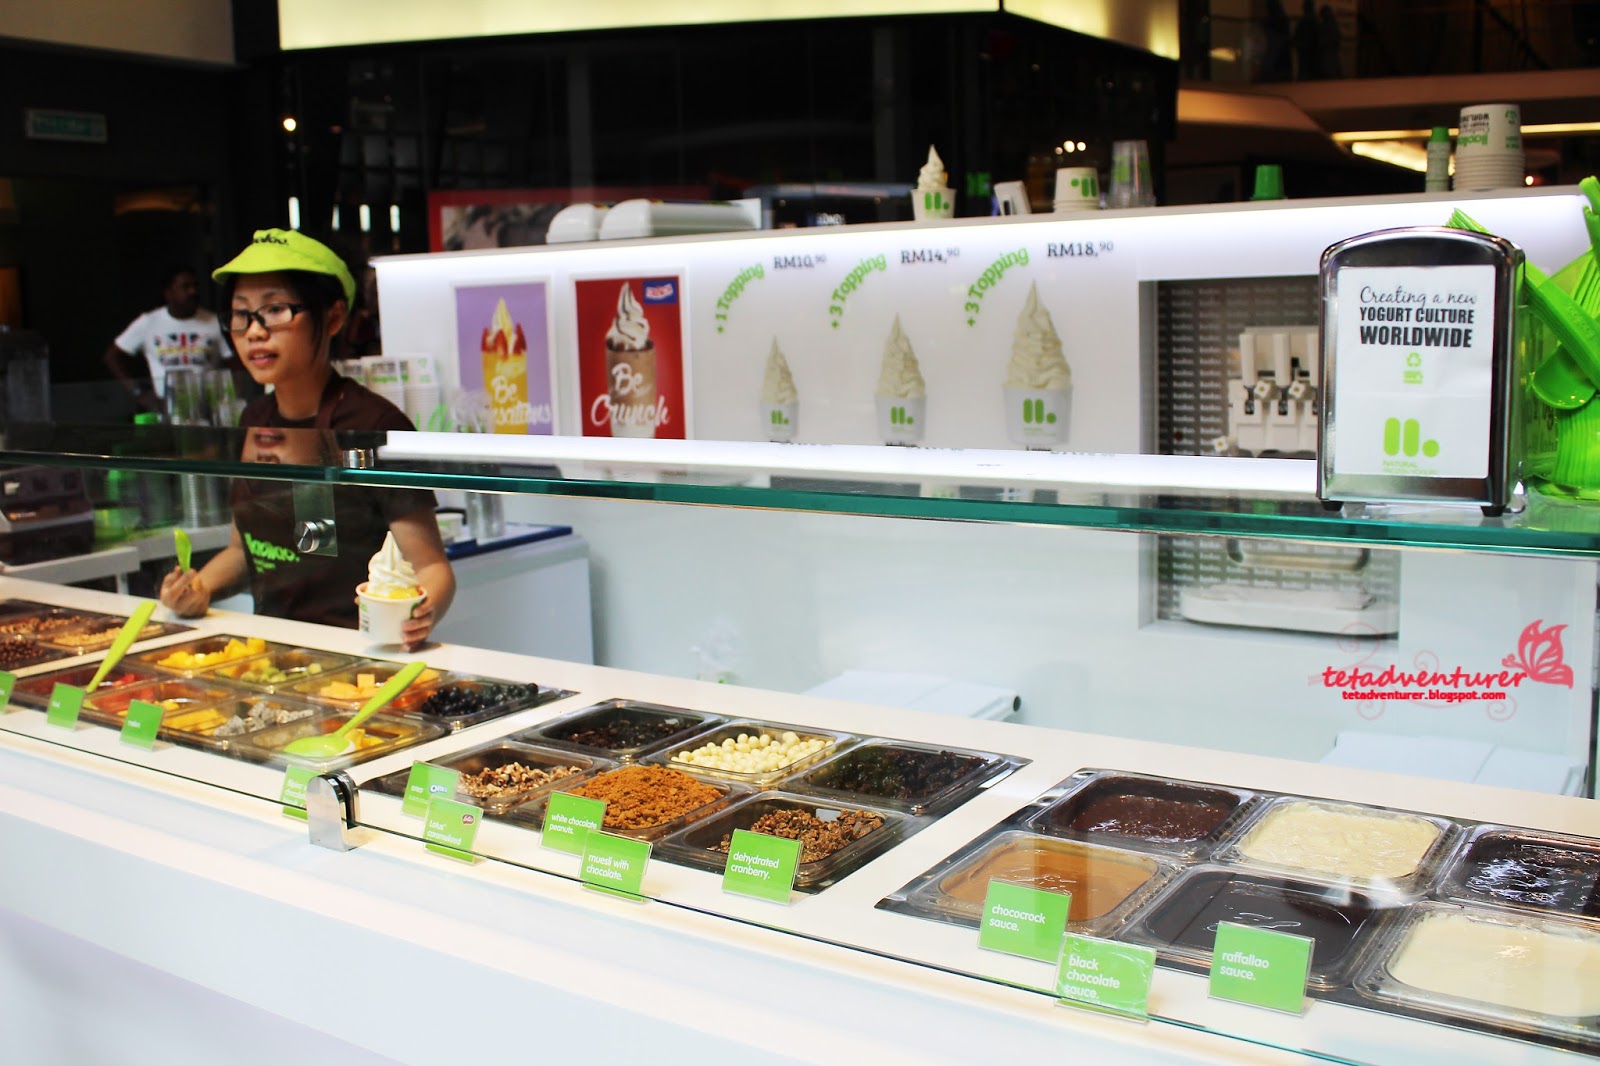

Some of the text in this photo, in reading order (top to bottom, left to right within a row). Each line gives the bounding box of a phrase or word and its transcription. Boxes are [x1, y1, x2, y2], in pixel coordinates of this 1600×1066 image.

[831, 253, 888, 303] Topping
[967, 247, 1029, 300] Topping
[716, 263, 765, 310] Topping
[1360, 285, 1478, 308] Creating a new
[1359, 306, 1475, 324] YOGURT CULTURE
[1359, 325, 1473, 348] WORLDWIDE
[611, 362, 649, 396] Be
[491, 375, 518, 404] Be
[590, 394, 671, 427] Crunch
[549, 823, 575, 835] peanuts.
[551, 813, 598, 830] white chocolate
[588, 854, 630, 870] muesli with
[733, 851, 780, 869] dehydrated
[586, 864, 623, 881] chocolate.
[730, 864, 771, 880] cranberry.
[991, 904, 1046, 925] chococrock
[988, 918, 1020, 932] sauce.
[1068, 953, 1099, 971] black
[1221, 951, 1270, 969] raffallao
[1066, 968, 1121, 989] chocolate
[1219, 965, 1256, 981] sauce.
[1063, 984, 1100, 1000] sauce.
